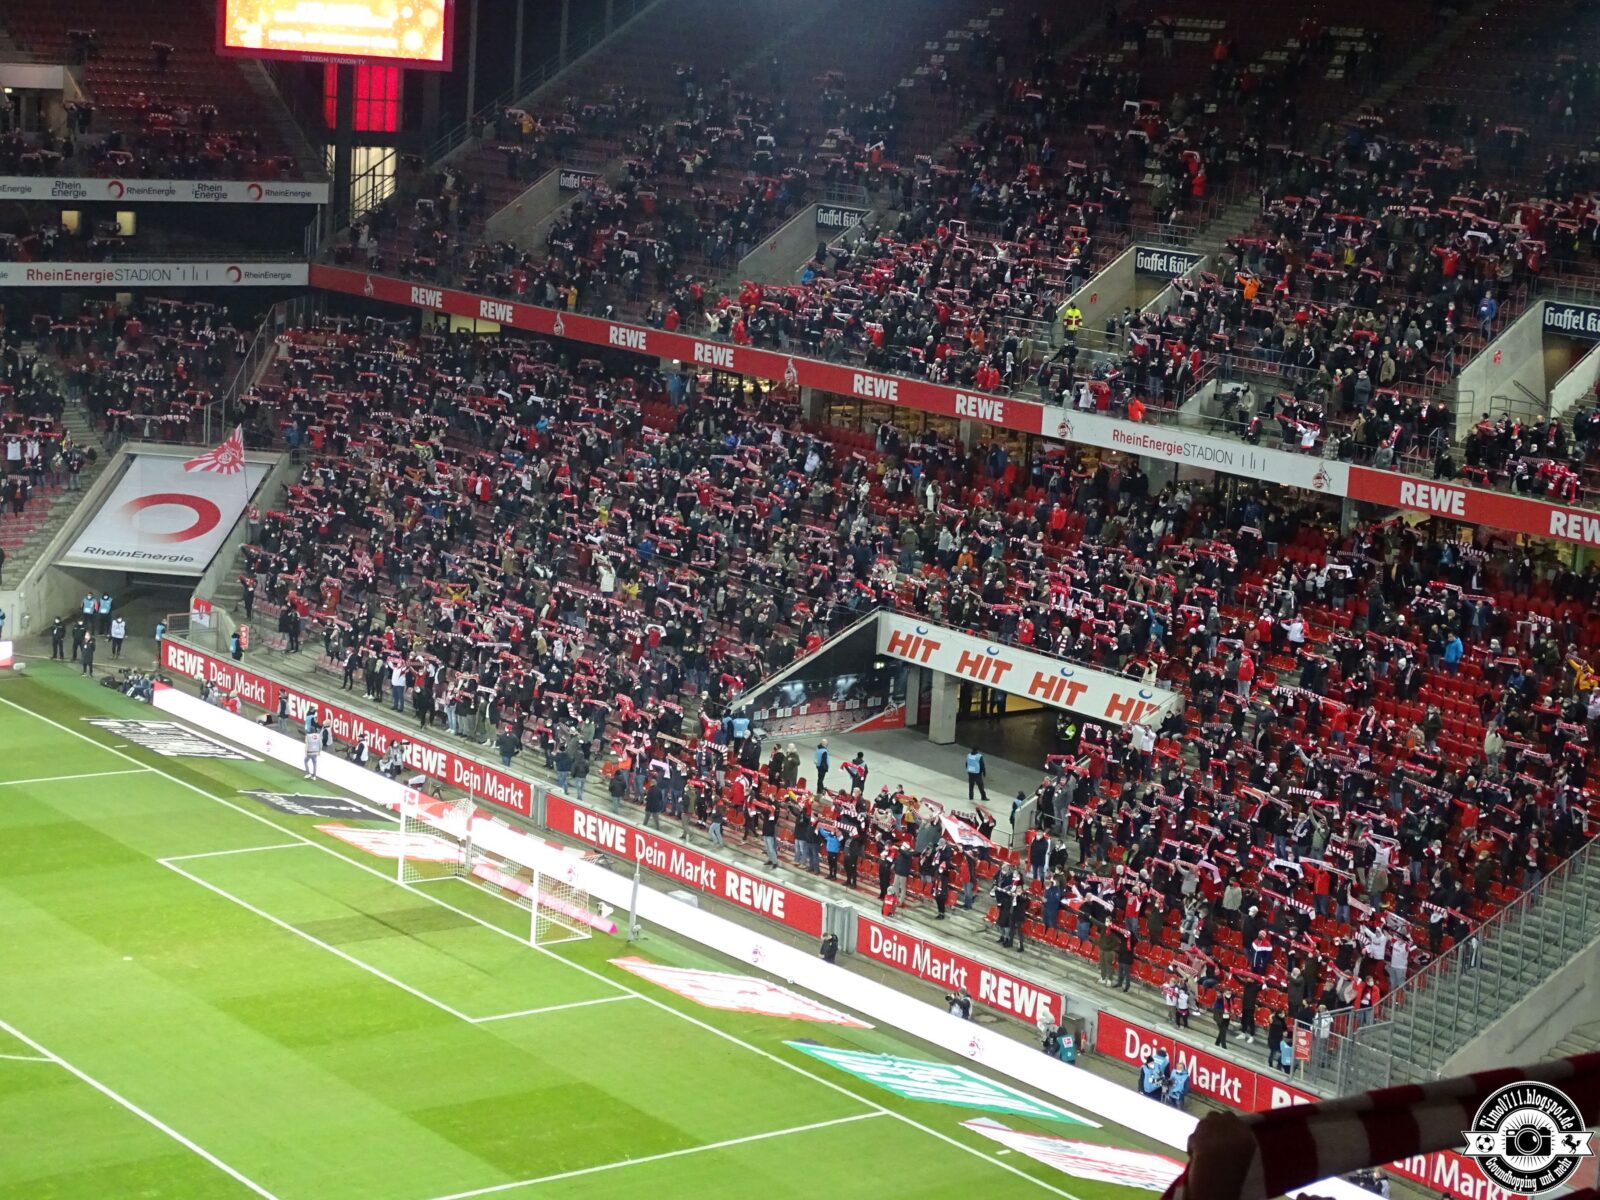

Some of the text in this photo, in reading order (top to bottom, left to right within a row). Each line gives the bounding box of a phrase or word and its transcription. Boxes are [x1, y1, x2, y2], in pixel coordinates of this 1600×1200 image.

[51, 188, 87, 198] Energie
[55, 181, 81, 189] Rhein
[126, 187, 176, 196] RheinEnergie
[194, 190, 228, 200] Energie
[198, 183, 222, 191] Rhein
[817, 208, 842, 226] Gaffel
[1136, 252, 1168, 272] Gaffel
[245, 271, 291, 280] RheinEnergie
[411, 286, 443, 309] REWE
[480, 300, 513, 323] REWE
[1544, 306, 1585, 330] Gaffel
[609, 326, 647, 350] REWE
[694, 343, 734, 368] REWE
[853, 374, 898, 401] REWE
[955, 394, 1003, 423] REWE
[1400, 481, 1466, 516] REWE
[1550, 510, 1600, 544] REW
[83, 546, 194, 562] RheinEnergie
[887, 630, 941, 663] HIT
[168, 646, 265, 703] REWE Dein Markt
[955, 650, 1013, 684] HIT
[1028, 671, 1088, 706] HIT
[325, 708, 349, 738] Dein
[352, 719, 386, 753] Markt
[402, 739, 524, 809] REWE Dein Markt
[573, 810, 785, 919] REWE Dein Markt REWE
[870, 926, 1052, 1023] Dein Markt REWE
[1177, 1050, 1241, 1103] Markt
